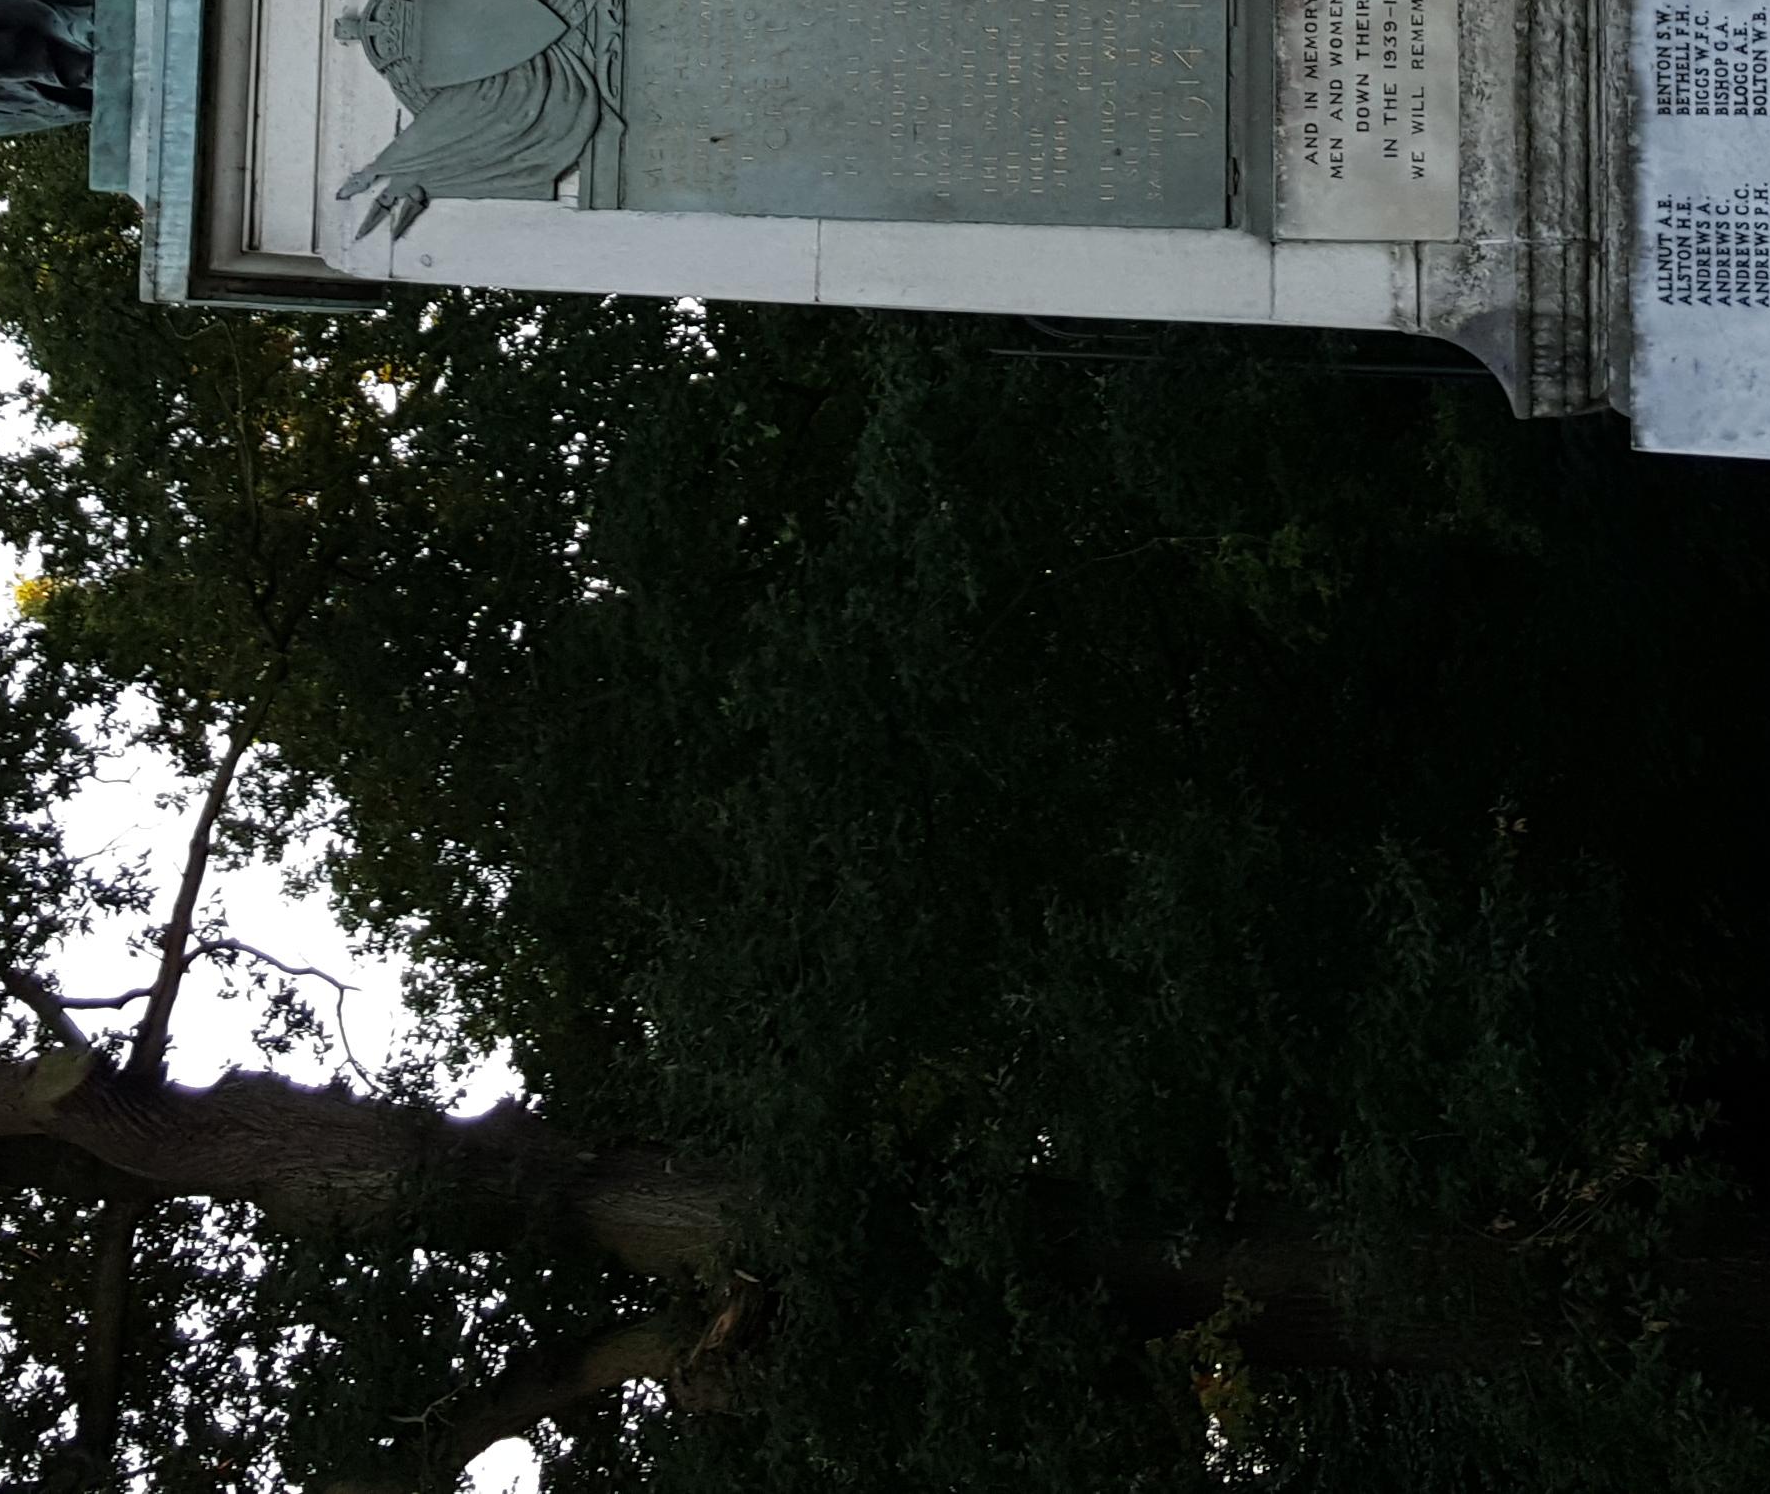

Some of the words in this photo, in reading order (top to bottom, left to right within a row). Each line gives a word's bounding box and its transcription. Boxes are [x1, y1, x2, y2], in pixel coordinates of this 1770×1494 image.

[1356, 0, 1370, 61] THEIR
[1655, 5, 1671, 40] S.W.
[1675, 4, 1690, 36] F.H.
[1695, 10, 1709, 61] W.F.C.
[1714, 16, 1729, 52] G.A.
[1733, 22, 1748, 55] A.E.
[1752, 7, 1767, 43] W.B.
[1656, 46, 1673, 116] BENTON
[1675, 42, 1690, 115] BETHELL
[1695, 68, 1709, 116] BIGGS
[1714, 58, 1729, 116] BISHOP
[1734, 63, 1749, 118] BLOGG
[1752, 50, 1767, 116] BOLTON
[1304, 92, 1318, 109] IN
[1329, 79, 1343, 121] AND
[1356, 74, 1370, 132] DOWN
[1383, 83, 1397, 126] THE
[1411, 86, 1425, 135] WILL
[1304, 123, 1319, 165] AND
[1330, 138, 1343, 179] MEN
[1383, 139, 1398, 158] IN
[1411, 152, 1425, 179] WE
[1656, 194, 1672, 228] A.E.
[1676, 196, 1692, 229] H.E.
[1696, 196, 1711, 215] A.
[1715, 199, 1730, 215] C.
[1734, 183, 1749, 216] C.C.
[1753, 183, 1769, 216] P.H.
[1657, 232, 1674, 305] ALLNUT
[1677, 236, 1693, 306] ALSTON
[1696, 221, 1712, 306] ANDREWS
[1715, 221, 1732, 307] ANDREWS
[1735, 222, 1751, 308] ANDREWS
[1754, 222, 1770, 308] ANDREWS
